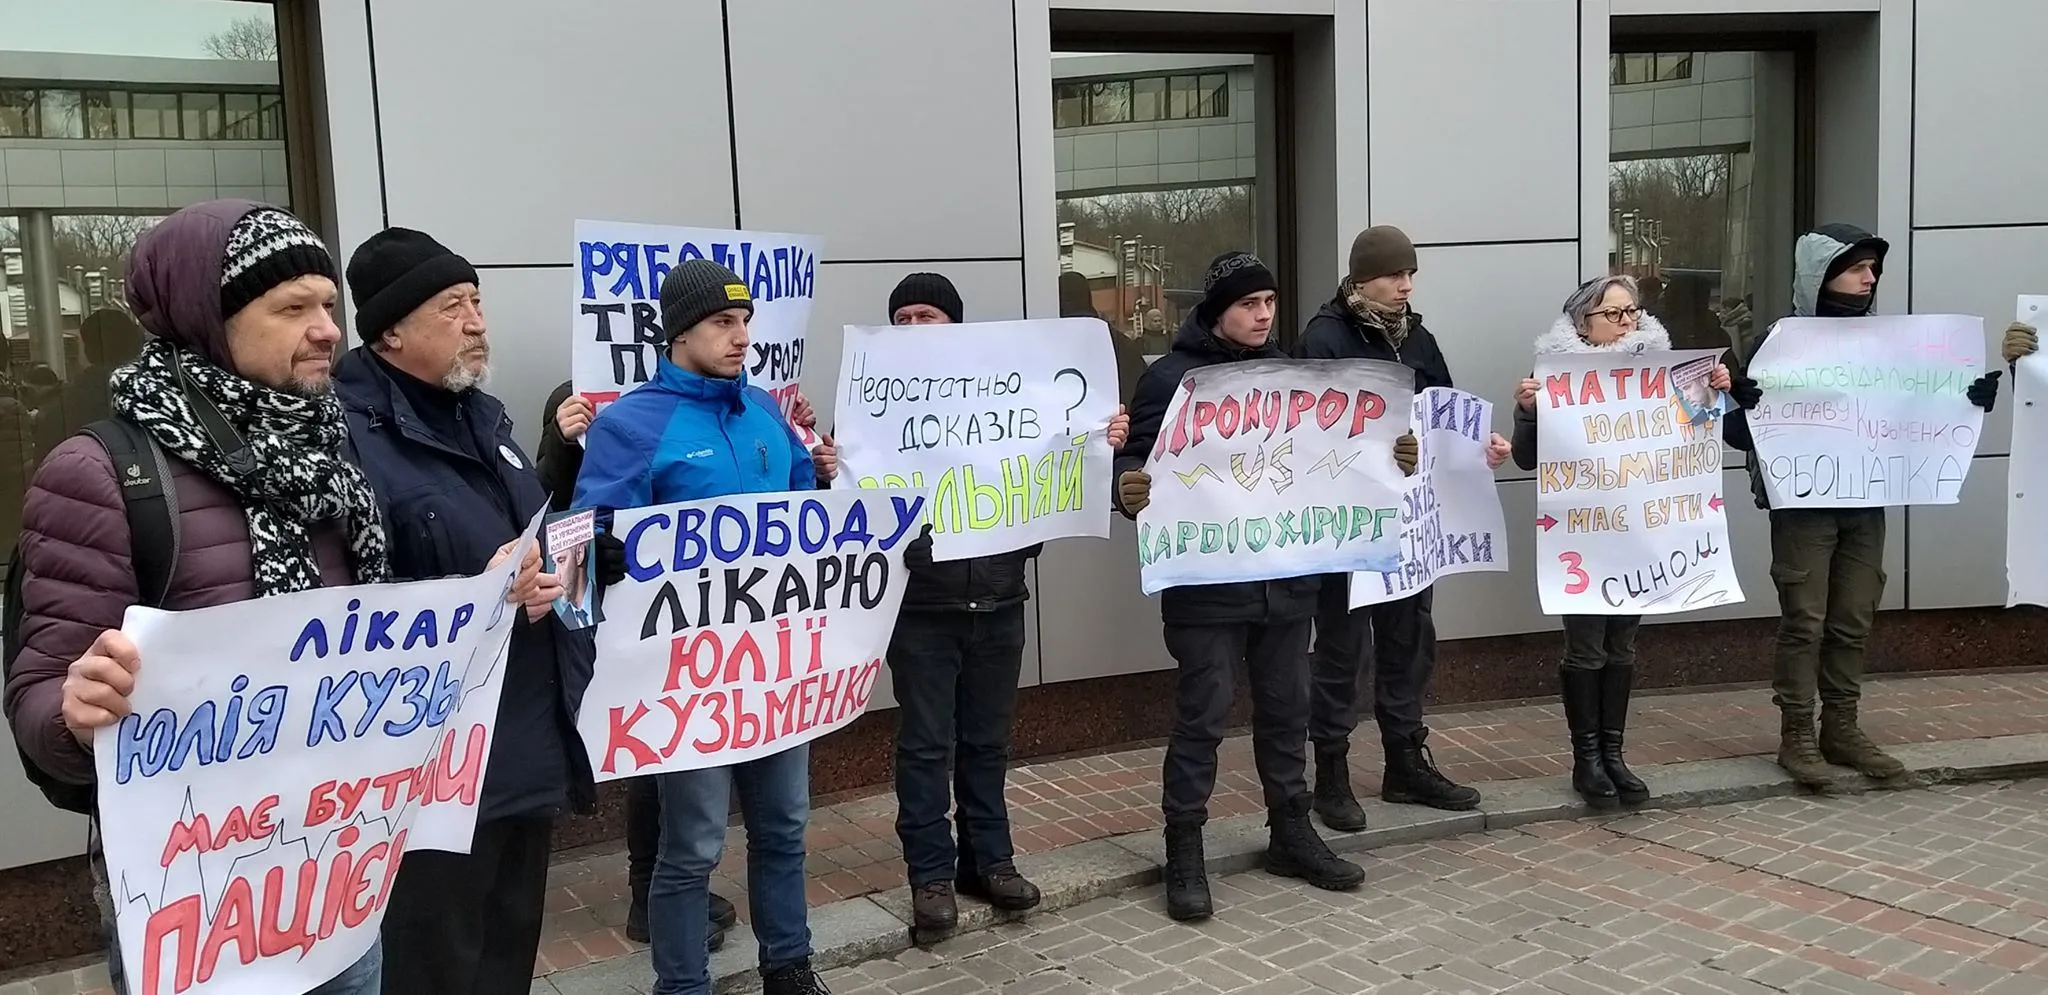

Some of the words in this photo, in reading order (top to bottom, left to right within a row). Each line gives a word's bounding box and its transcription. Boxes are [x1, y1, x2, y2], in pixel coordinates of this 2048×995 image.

[848, 352, 1021, 418] Недостатньо
[1546, 367, 1666, 408] МАТИ
[1752, 403, 1771, 421] ЗА
[1781, 400, 1850, 421] СПРАВУ
[898, 408, 1041, 453] ДОКАЗІВ
[1583, 406, 1672, 444] ЮЛІЯ
[1540, 439, 1720, 494] КУЗЬМЕНКО
[1763, 453, 1963, 501] ЯБОШАПКА
[624, 496, 925, 582] СВОБОДУ
[1568, 505, 1628, 533] МАЄ
[1643, 493, 1703, 529] БУТИ
[640, 552, 889, 640] ЛІКАРЮ
[290, 599, 474, 661] ЛІКАР
[662, 616, 827, 692] ЮЛІЇ
[116, 675, 288, 784] ЮЛІЯ
[600, 657, 881, 773] КУЗЬМЕНКО
[160, 795, 280, 868] МАЄ
